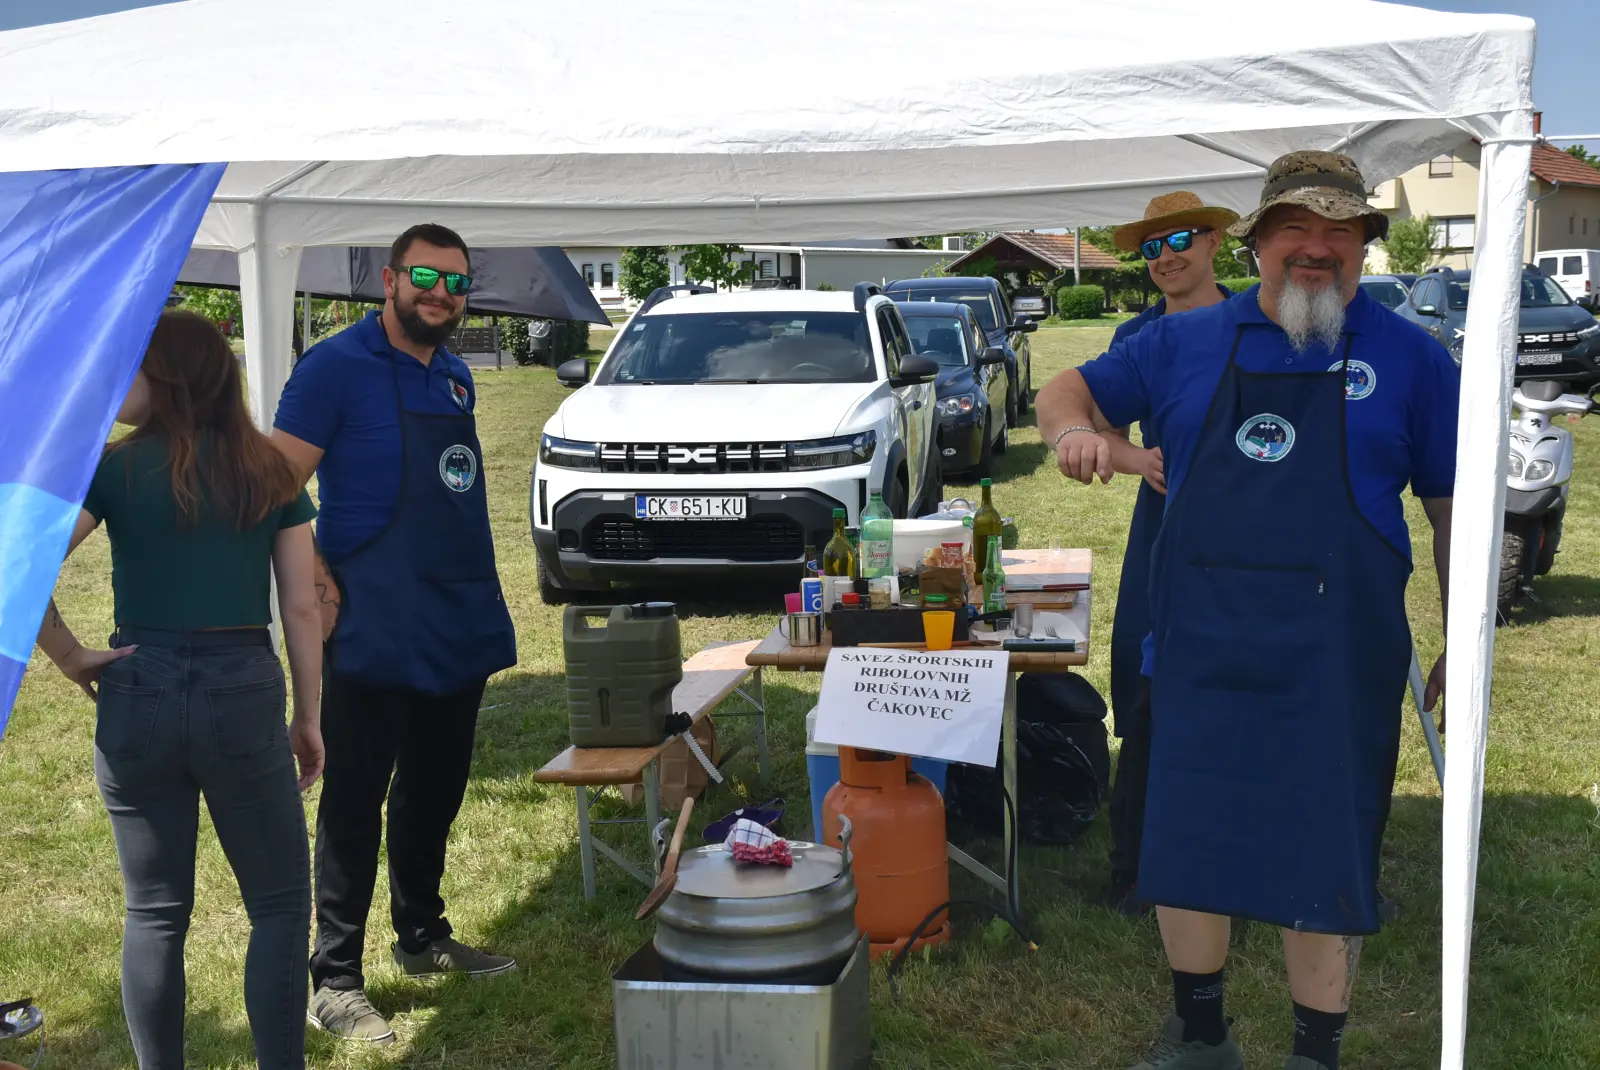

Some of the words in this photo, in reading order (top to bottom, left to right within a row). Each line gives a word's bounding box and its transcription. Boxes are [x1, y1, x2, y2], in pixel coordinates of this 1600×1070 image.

[648, 498, 668, 516] CK
[681, 498, 742, 516] 651-KU
[840, 653, 893, 663] SAVEZ
[897, 653, 993, 669] ŠPORTSKIH
[860, 667, 970, 684] RIBOLOVNIH
[853, 682, 940, 699] DRUŠTAVA
[944, 689, 972, 703] MŽ
[867, 698, 954, 721] ČAKOVEC
